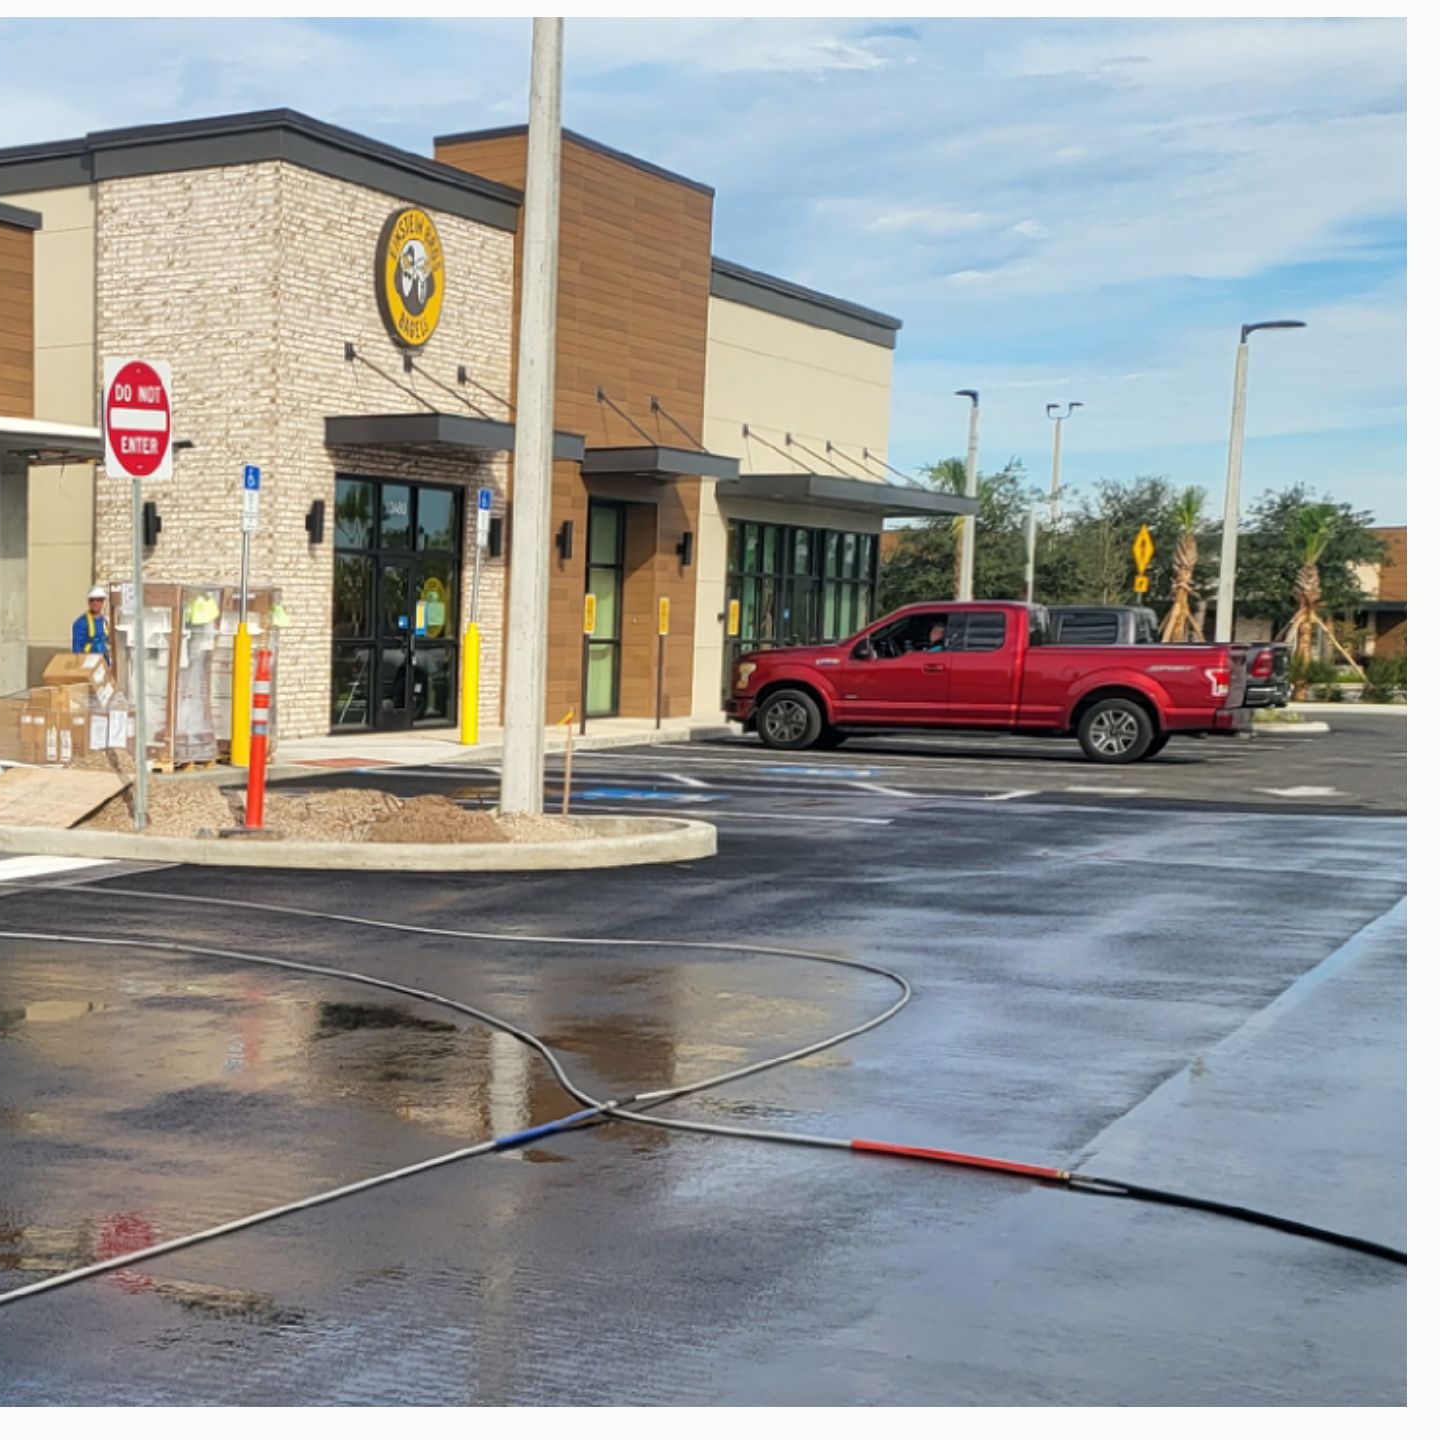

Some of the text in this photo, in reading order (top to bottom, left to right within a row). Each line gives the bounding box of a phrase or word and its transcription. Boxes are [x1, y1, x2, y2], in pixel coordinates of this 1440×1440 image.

[114, 383, 162, 404] DO NOT
[121, 436, 159, 456] ENTER
